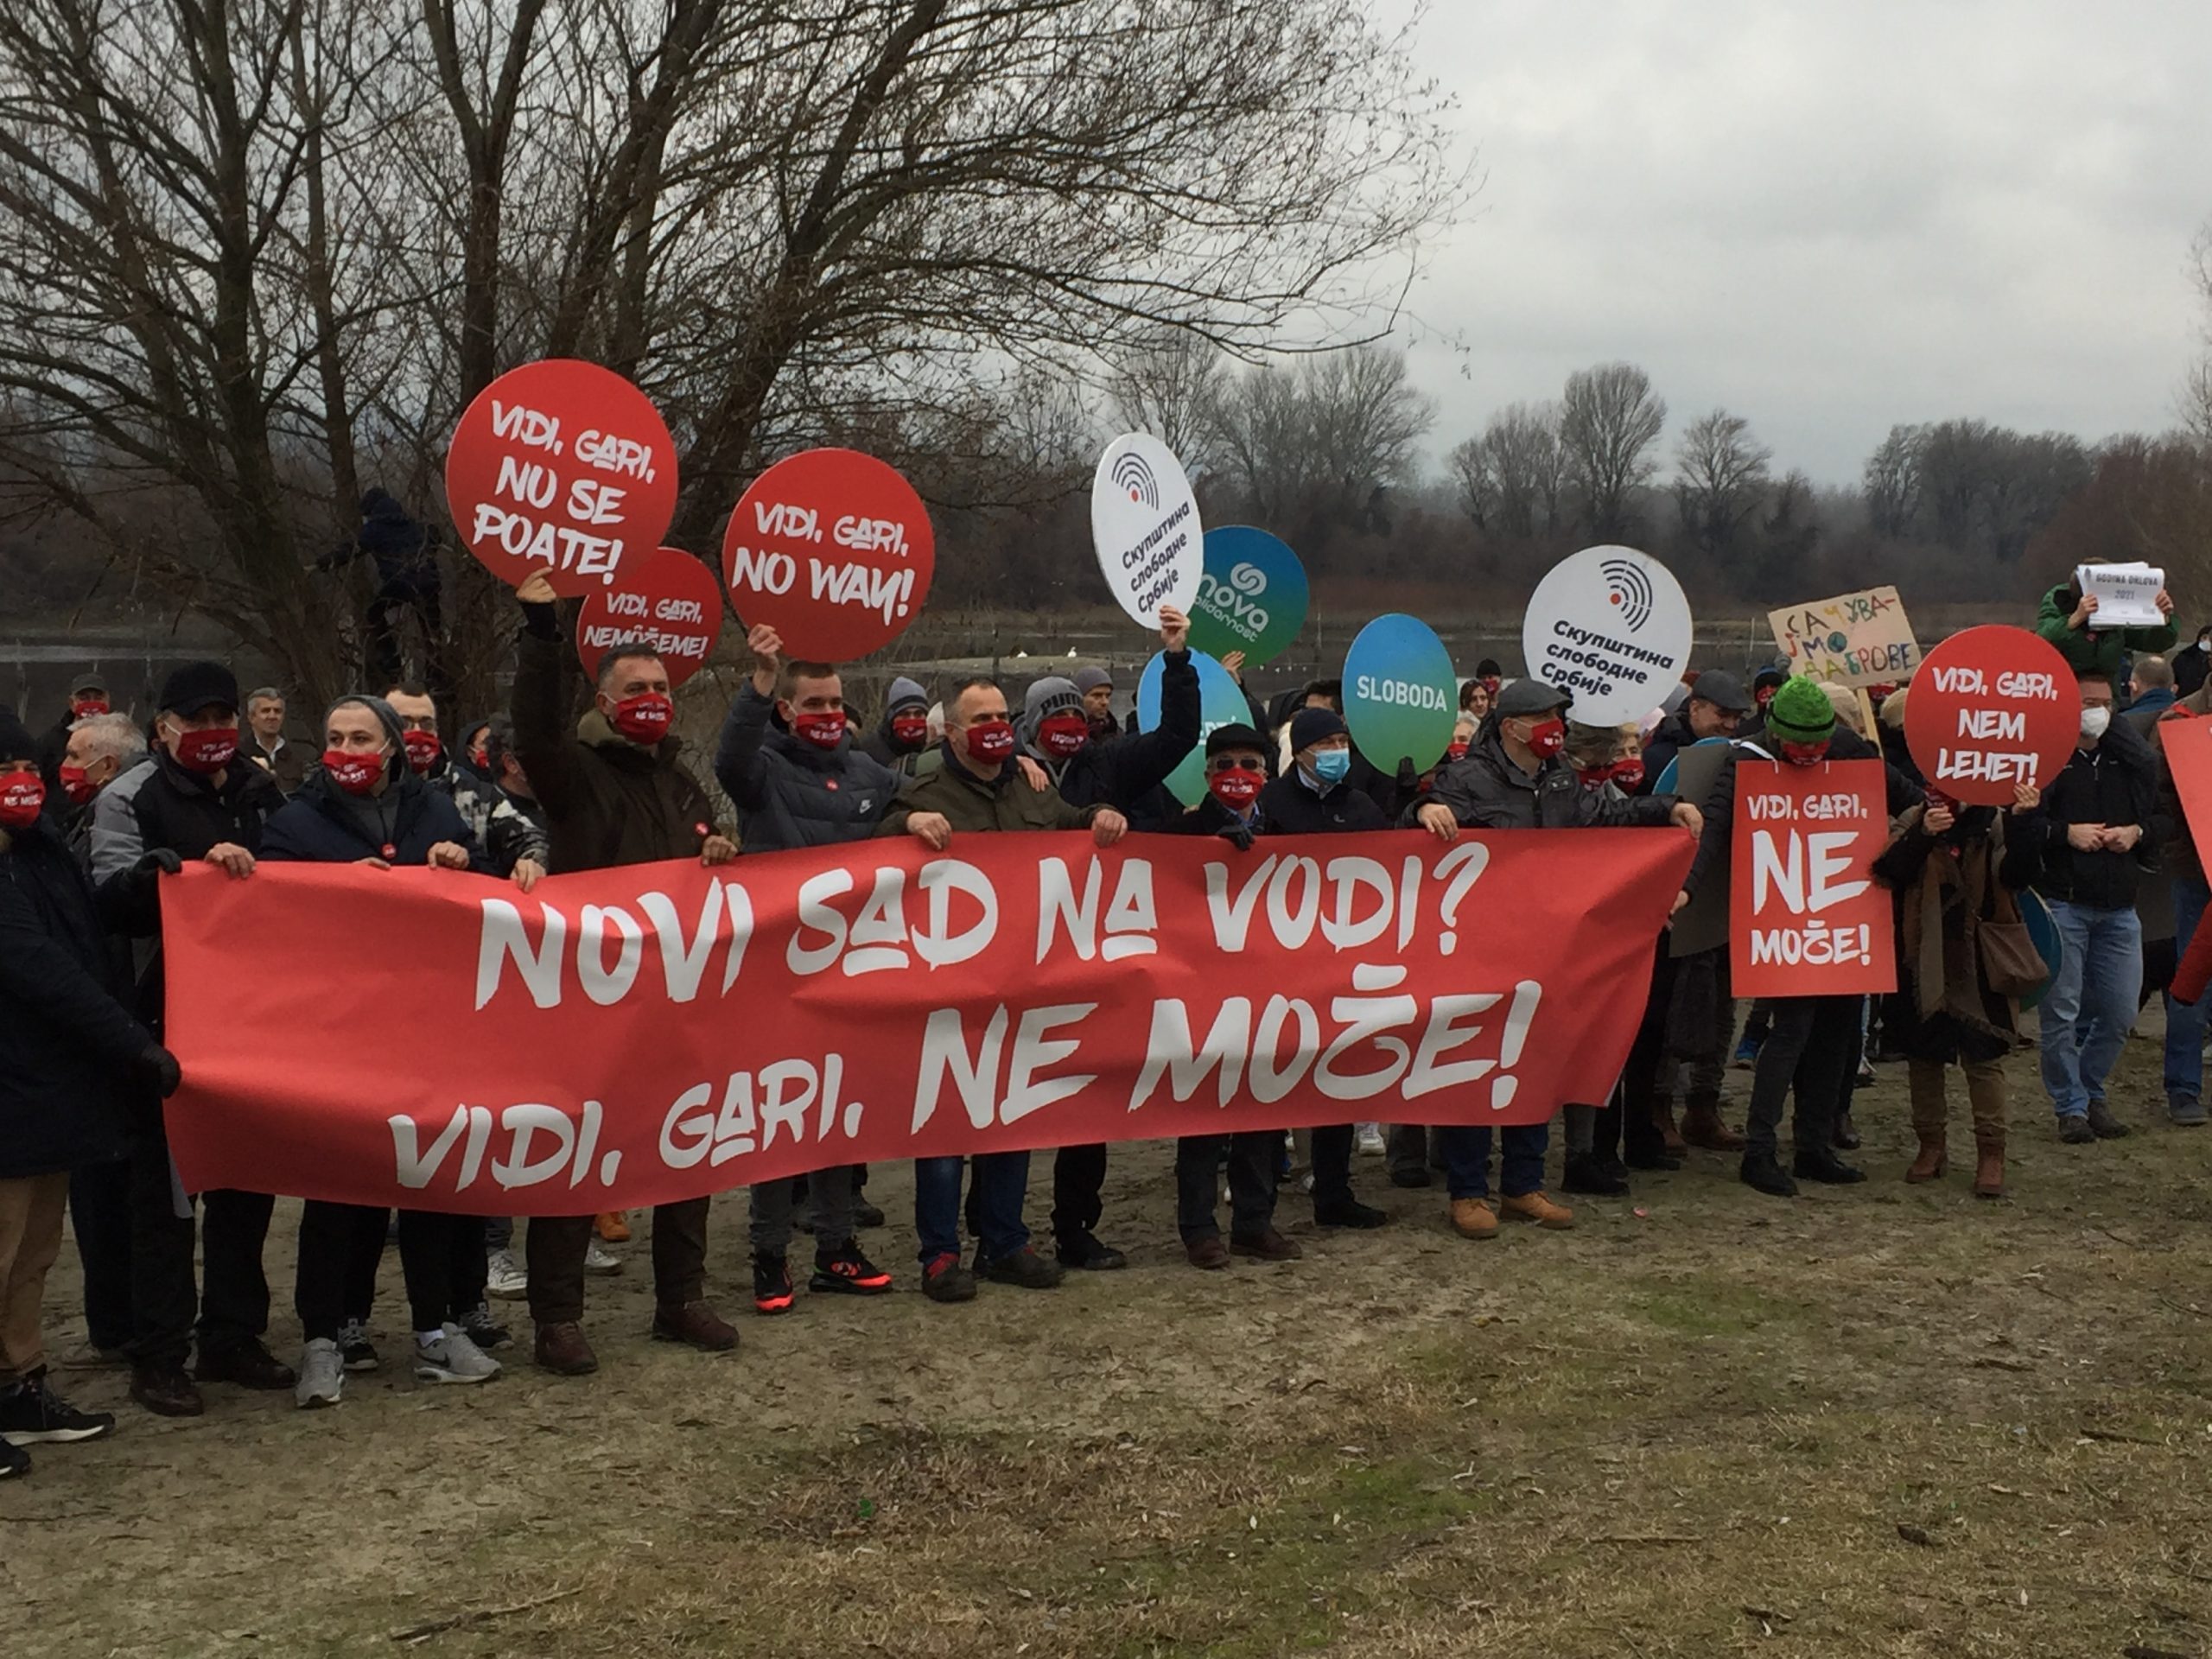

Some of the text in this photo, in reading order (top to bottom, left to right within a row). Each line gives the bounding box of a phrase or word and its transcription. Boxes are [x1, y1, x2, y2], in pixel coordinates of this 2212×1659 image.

[492, 400, 655, 484] VIDI, GARI,
[495, 456, 626, 524] NU SE
[473, 503, 623, 585] POATE!
[754, 501, 909, 556] VIDI, GARI,
[1122, 501, 1190, 569] Скупштина
[732, 546, 915, 626] NO WAY!
[1131, 532, 1186, 592] слободне
[607, 592, 702, 624] VIDI, GARI,
[1138, 569, 1179, 613] Србије
[1200, 574, 1268, 632] nova
[1194, 595, 1258, 642] olidarnost
[1547, 644, 1648, 683] слободне
[1554, 620, 1675, 669] Скупштина
[1357, 675, 1447, 712] SLOBODA
[1541, 663, 1612, 696] Србије
[1932, 667, 2058, 701] VIDI, GARI,
[1958, 709, 2025, 742] NEM
[1936, 748, 2038, 786] LEHET!
[1747, 793, 1868, 820] VIDI, GARI,
[1752, 828, 1872, 916] NE
[475, 842, 1490, 1011] NOVI SAD NA VODI?
[1751, 919, 1871, 966] MOŽE!
[388, 963, 1542, 1192] VIDI, GARI, NE MOŽE!
